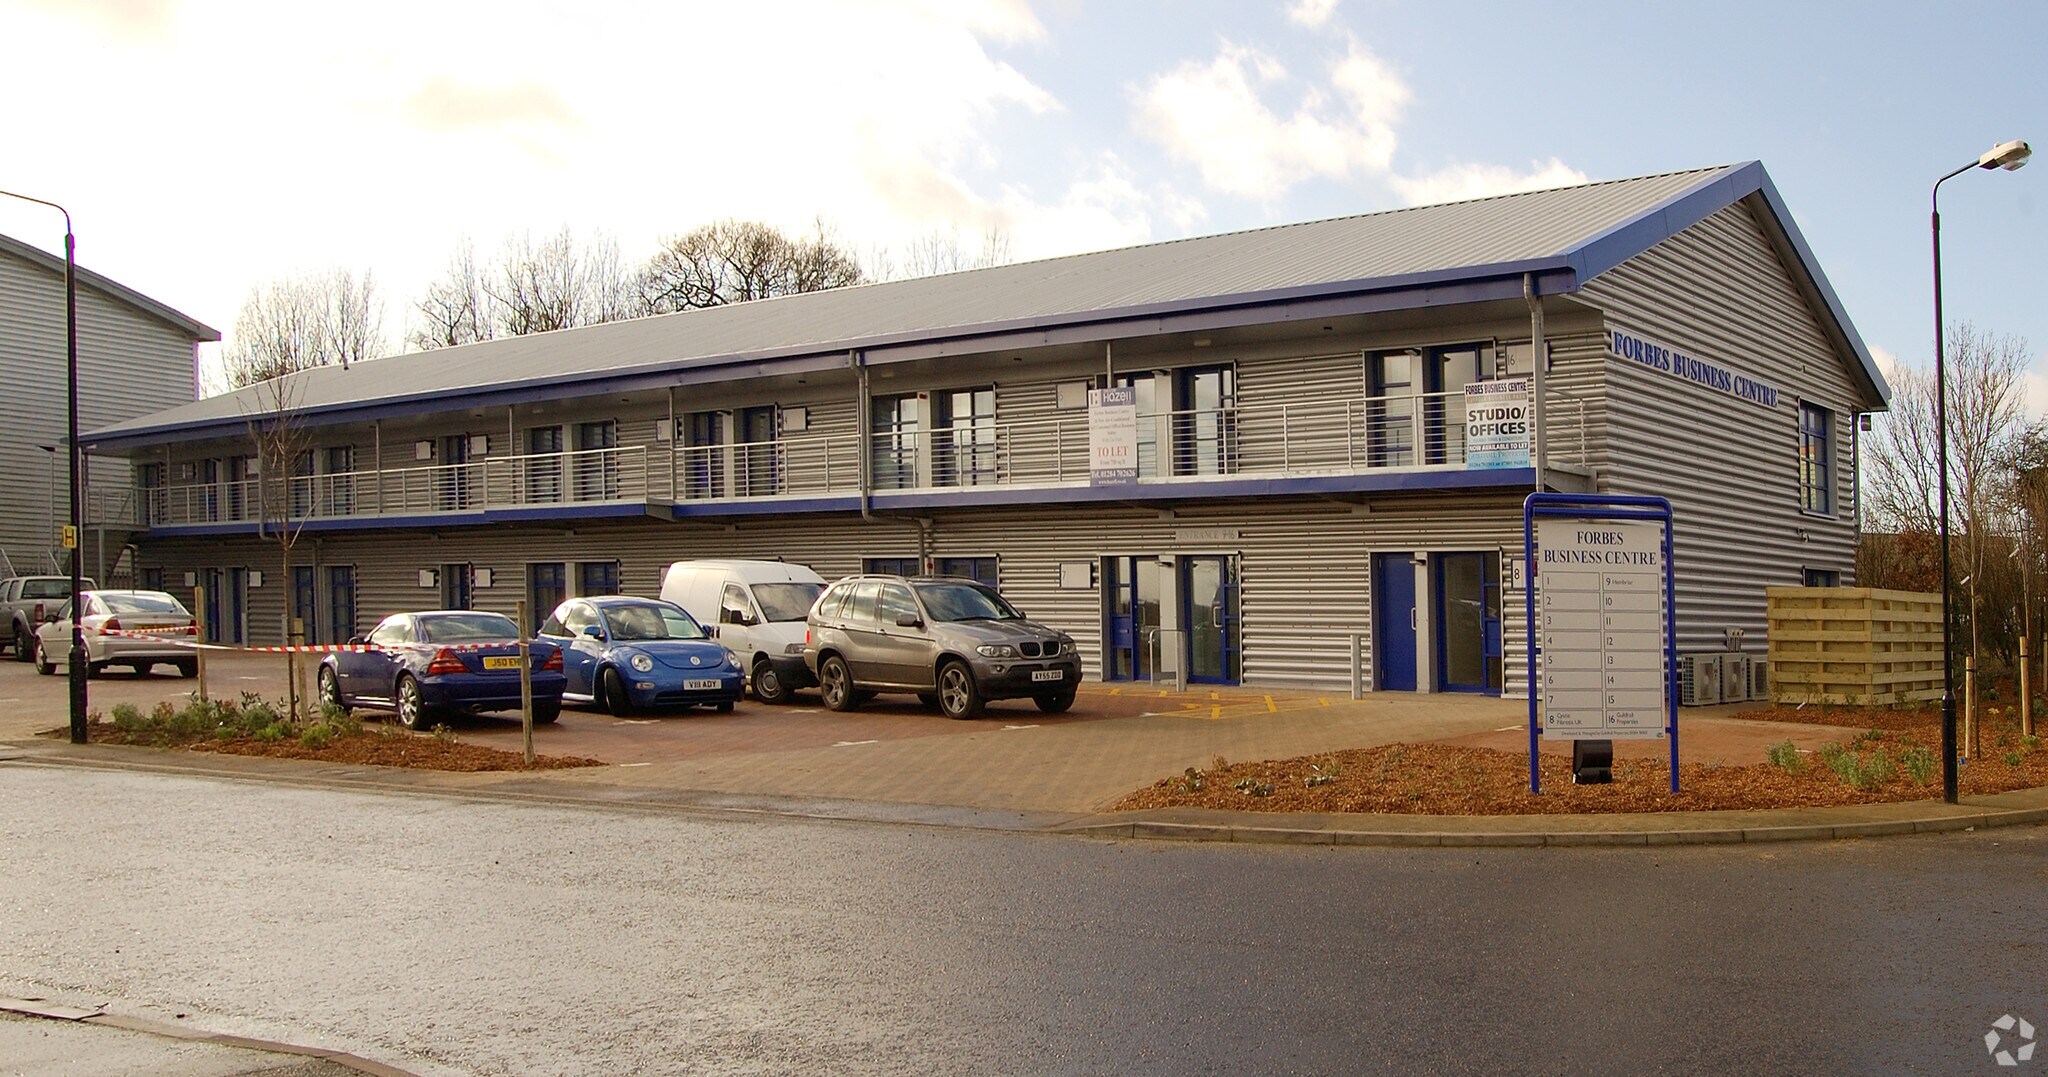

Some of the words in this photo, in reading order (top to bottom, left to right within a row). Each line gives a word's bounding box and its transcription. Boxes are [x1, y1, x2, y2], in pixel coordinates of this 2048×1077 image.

[1507, 354, 1516, 366] 16
[1613, 331, 1670, 371] FORBES
[1672, 352, 1731, 393] BUSINESS
[1733, 374, 1778, 408] CENTRE
[1465, 383, 1484, 396] FORBES
[1484, 382, 1508, 394] BUSINESS
[1507, 381, 1527, 393] CENTRE
[1102, 391, 1132, 403] Hazell
[1468, 406, 1527, 422] STUDIO/
[1469, 422, 1526, 437] OFFICES
[1096, 447, 1109, 458] TO
[1111, 446, 1128, 457] LET
[64, 528, 75, 546] H
[1179, 530, 1219, 540] ENTRANCE
[1576, 530, 1624, 546] FORBES
[1544, 549, 1602, 564] BUSINESS
[1605, 551, 1657, 566] CENTRE
[1514, 568, 1520, 580] 8
[1606, 577, 1611, 586] 9
[1546, 596, 1551, 605] 2
[1605, 597, 1613, 606] 10
[1547, 616, 1552, 625] 3
[1606, 617, 1611, 625] 11
[1547, 636, 1552, 645] 4
[1606, 637, 1613, 646] 12
[1548, 656, 1553, 664] 5
[1607, 656, 1614, 664] 13
[1035, 672, 1050, 680] AY55
[1548, 676, 1554, 684] 6
[1607, 676, 1614, 684] 14
[703, 680, 717, 688] ADY
[1549, 695, 1554, 704] 7
[1608, 695, 1615, 704] 15
[1549, 715, 1555, 724] 8
[1608, 715, 1616, 723] 16
